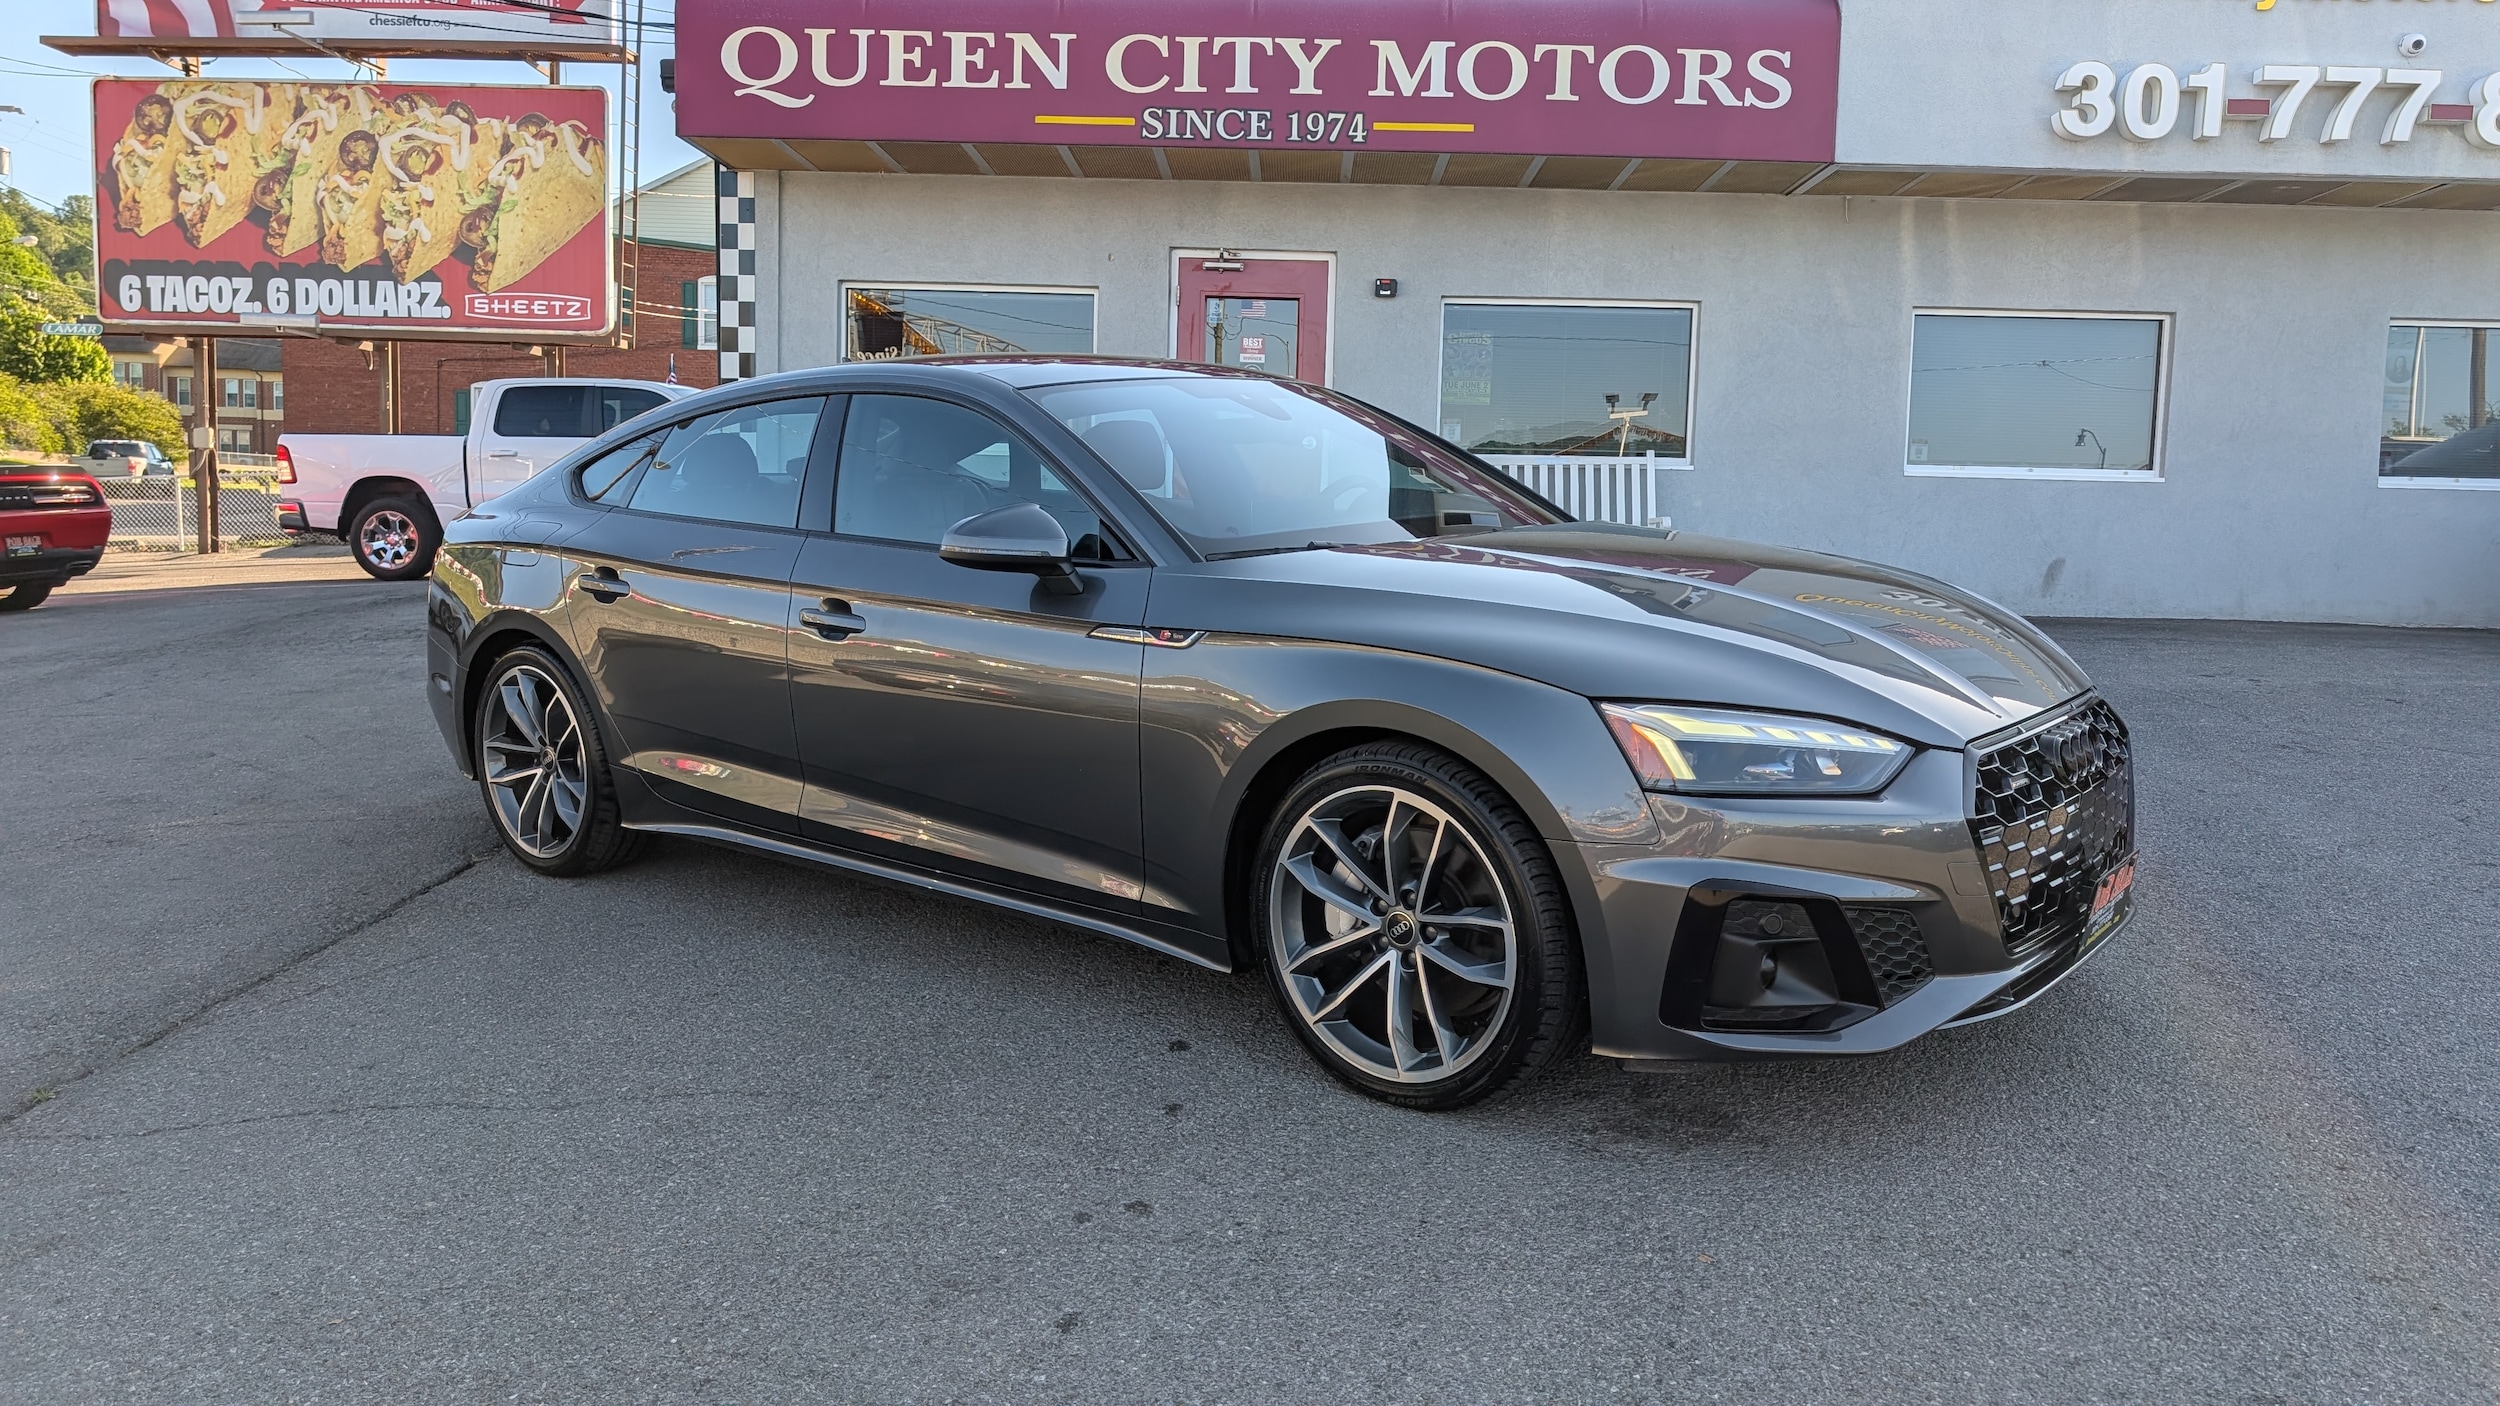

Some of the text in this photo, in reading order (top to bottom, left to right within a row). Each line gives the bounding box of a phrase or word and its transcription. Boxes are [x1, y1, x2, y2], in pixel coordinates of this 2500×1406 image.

[369, 14, 451, 30] chessiefcu.org
[721, 26, 1792, 110] QUEEN CITY MOTORS
[1141, 107, 1368, 143] SINCE 1974
[119, 275, 452, 319] 6 TACOZ. 6 DOLLARZ.
[474, 299, 582, 316] SHEETZ
[46, 325, 98, 334] LAMAR
[1242, 338, 1263, 346] BEST
[1461, 381, 1481, 389] JUNE
[1354, 765, 1429, 785] IRONMAN
